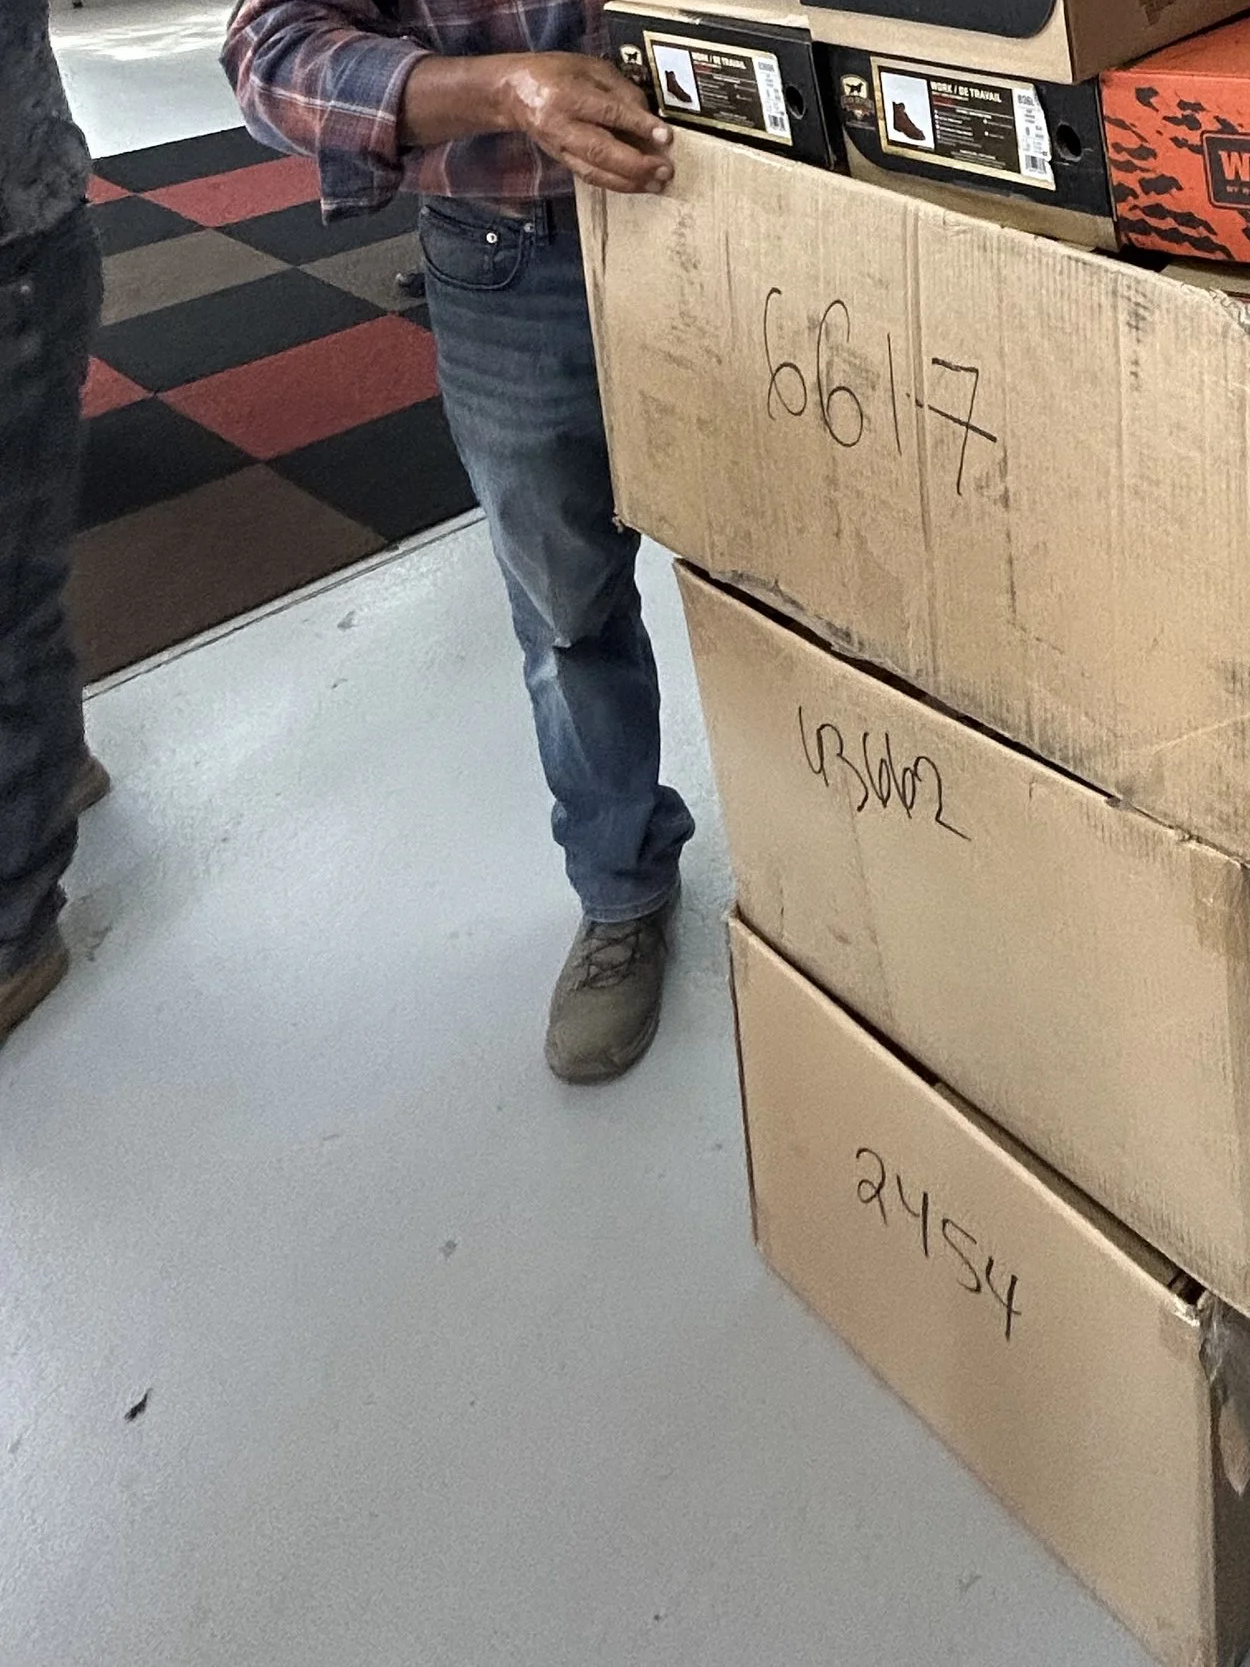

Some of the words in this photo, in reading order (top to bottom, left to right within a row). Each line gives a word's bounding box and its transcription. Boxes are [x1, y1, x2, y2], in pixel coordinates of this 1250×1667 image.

[958, 86, 970, 97] DE
[970, 88, 1002, 103] TRAVAIL
[1226, 185, 1240, 194] BY
[763, 286, 998, 496] 6617
[856, 1146, 1023, 1343] 2454
